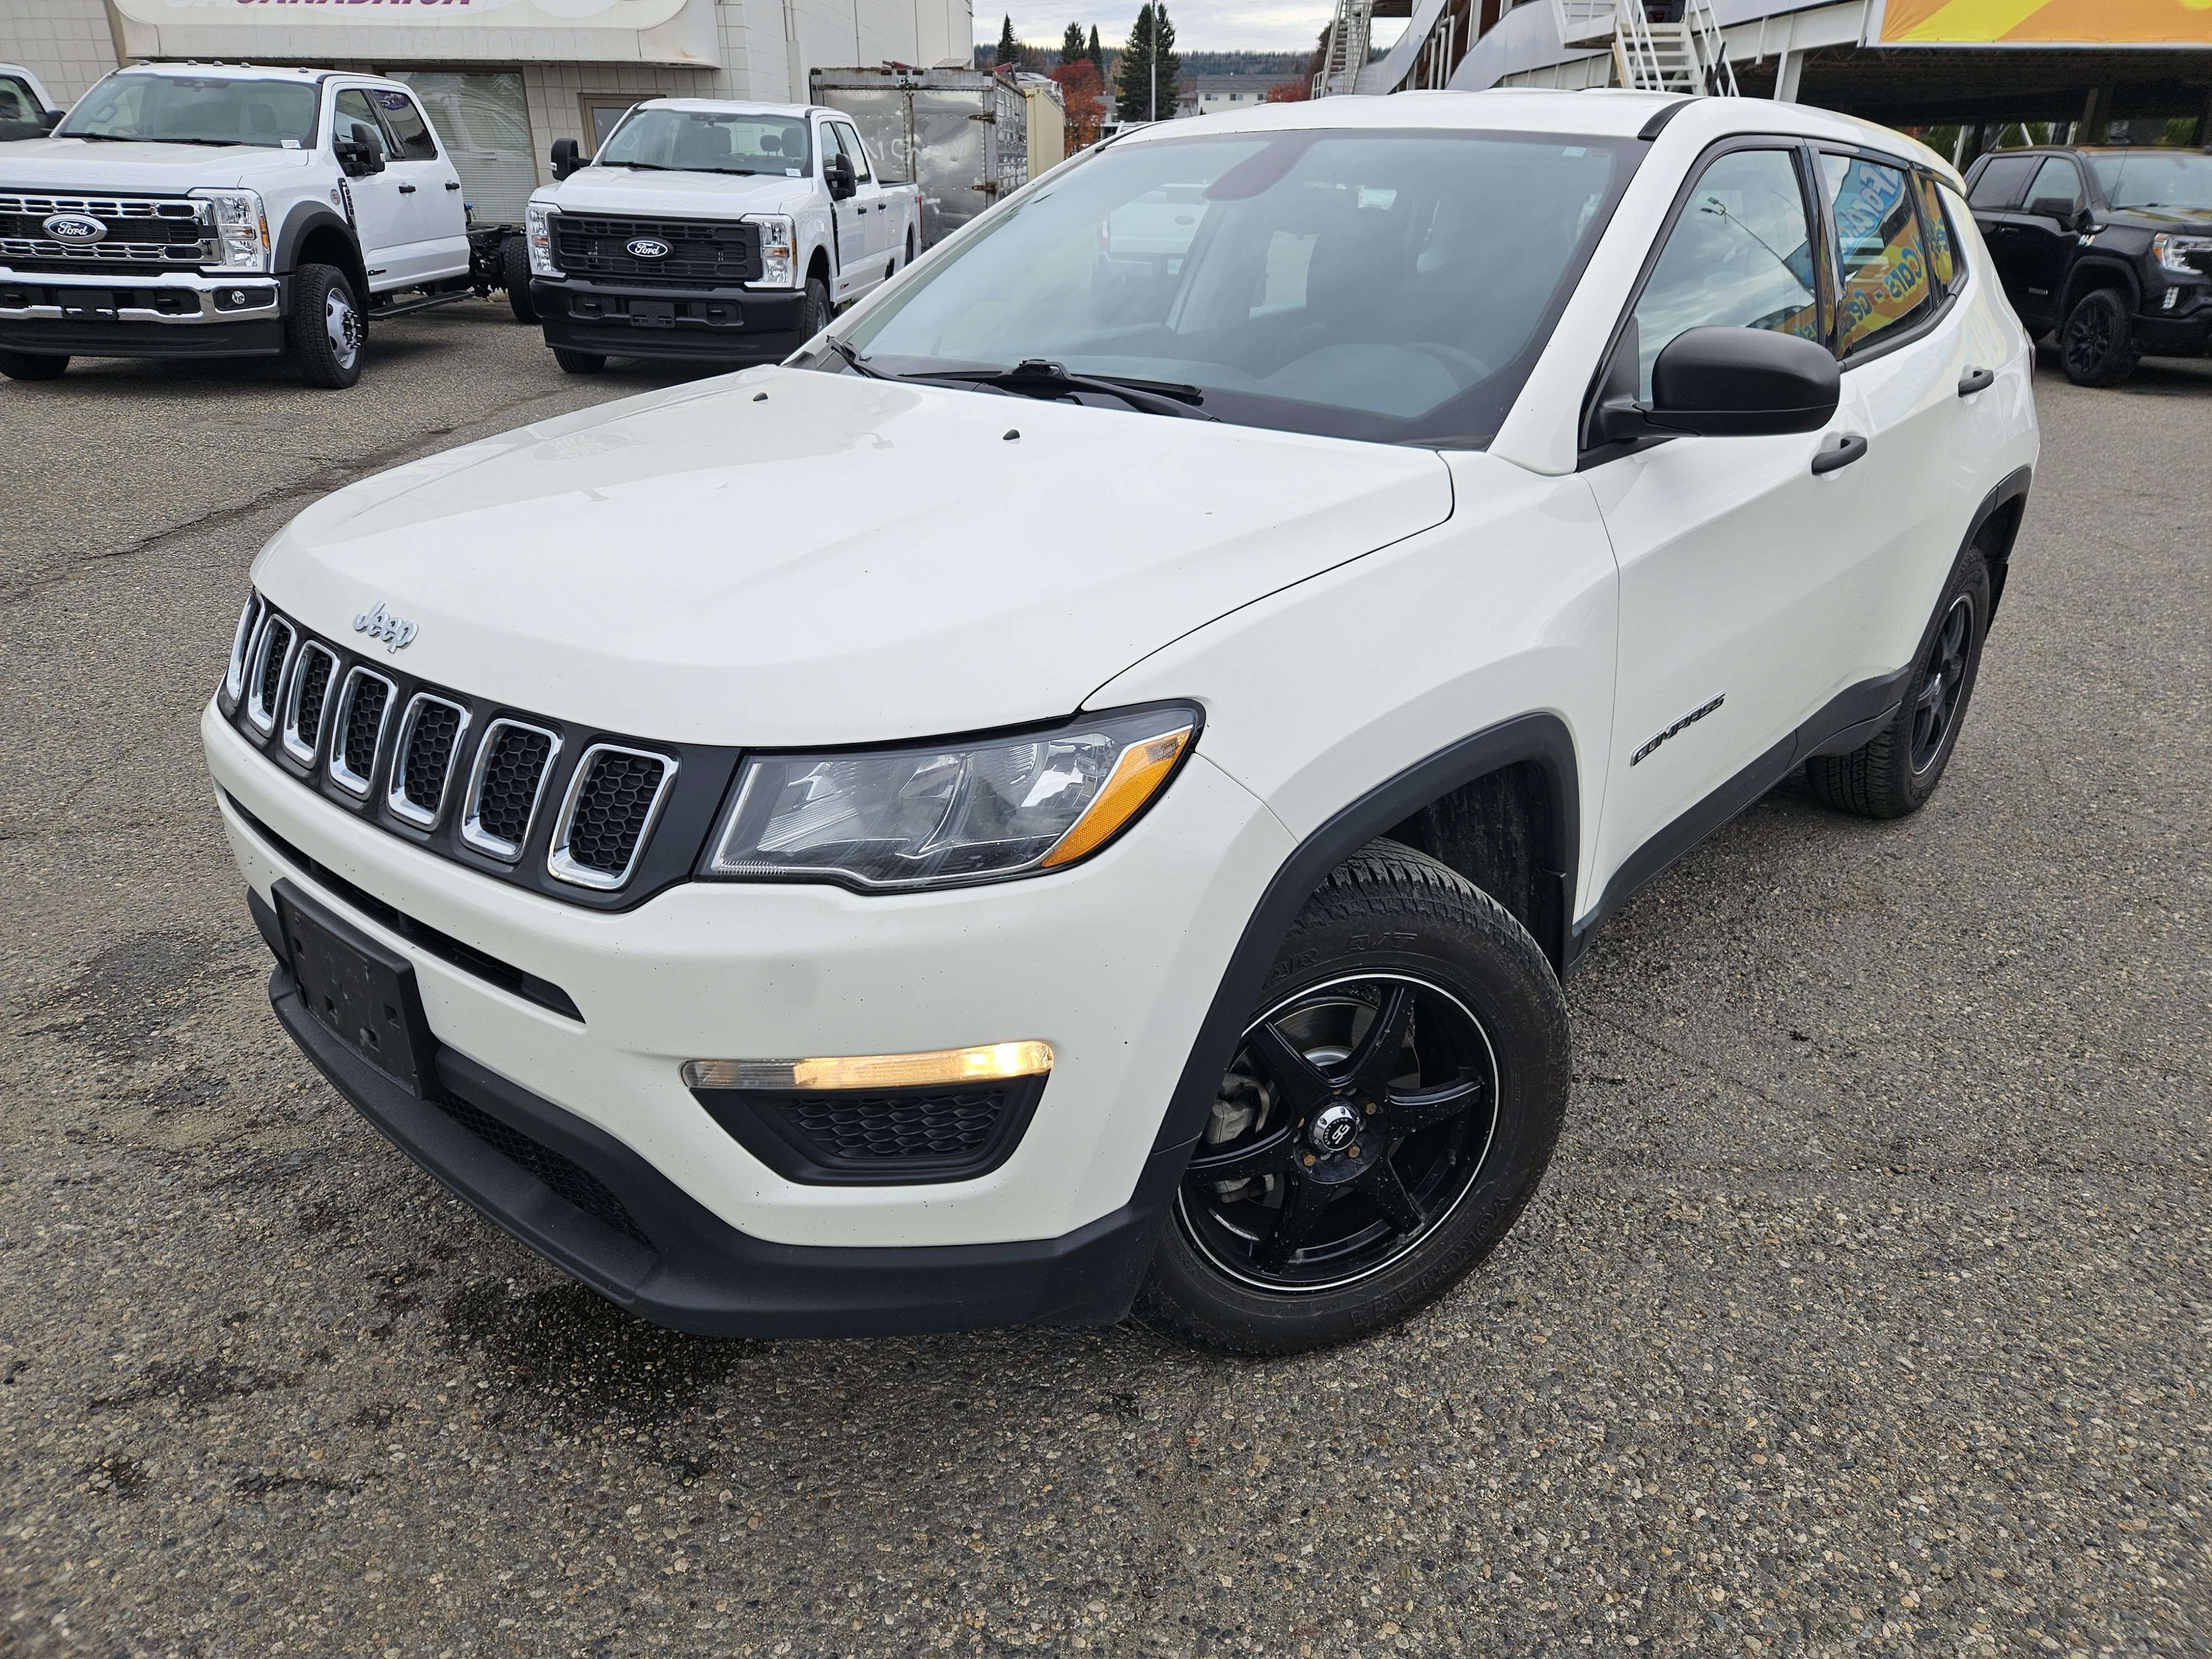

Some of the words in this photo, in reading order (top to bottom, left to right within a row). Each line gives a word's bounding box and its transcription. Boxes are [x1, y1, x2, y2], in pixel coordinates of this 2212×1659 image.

[462, 30, 594, 56] MOTORS
[57, 221, 88, 236] Ford
[634, 242, 660, 255] Ford
[353, 601, 419, 654] Jeep
[1630, 691, 1726, 766] COMPASS
[1351, 1196, 1511, 1326] YOKOHAMA
